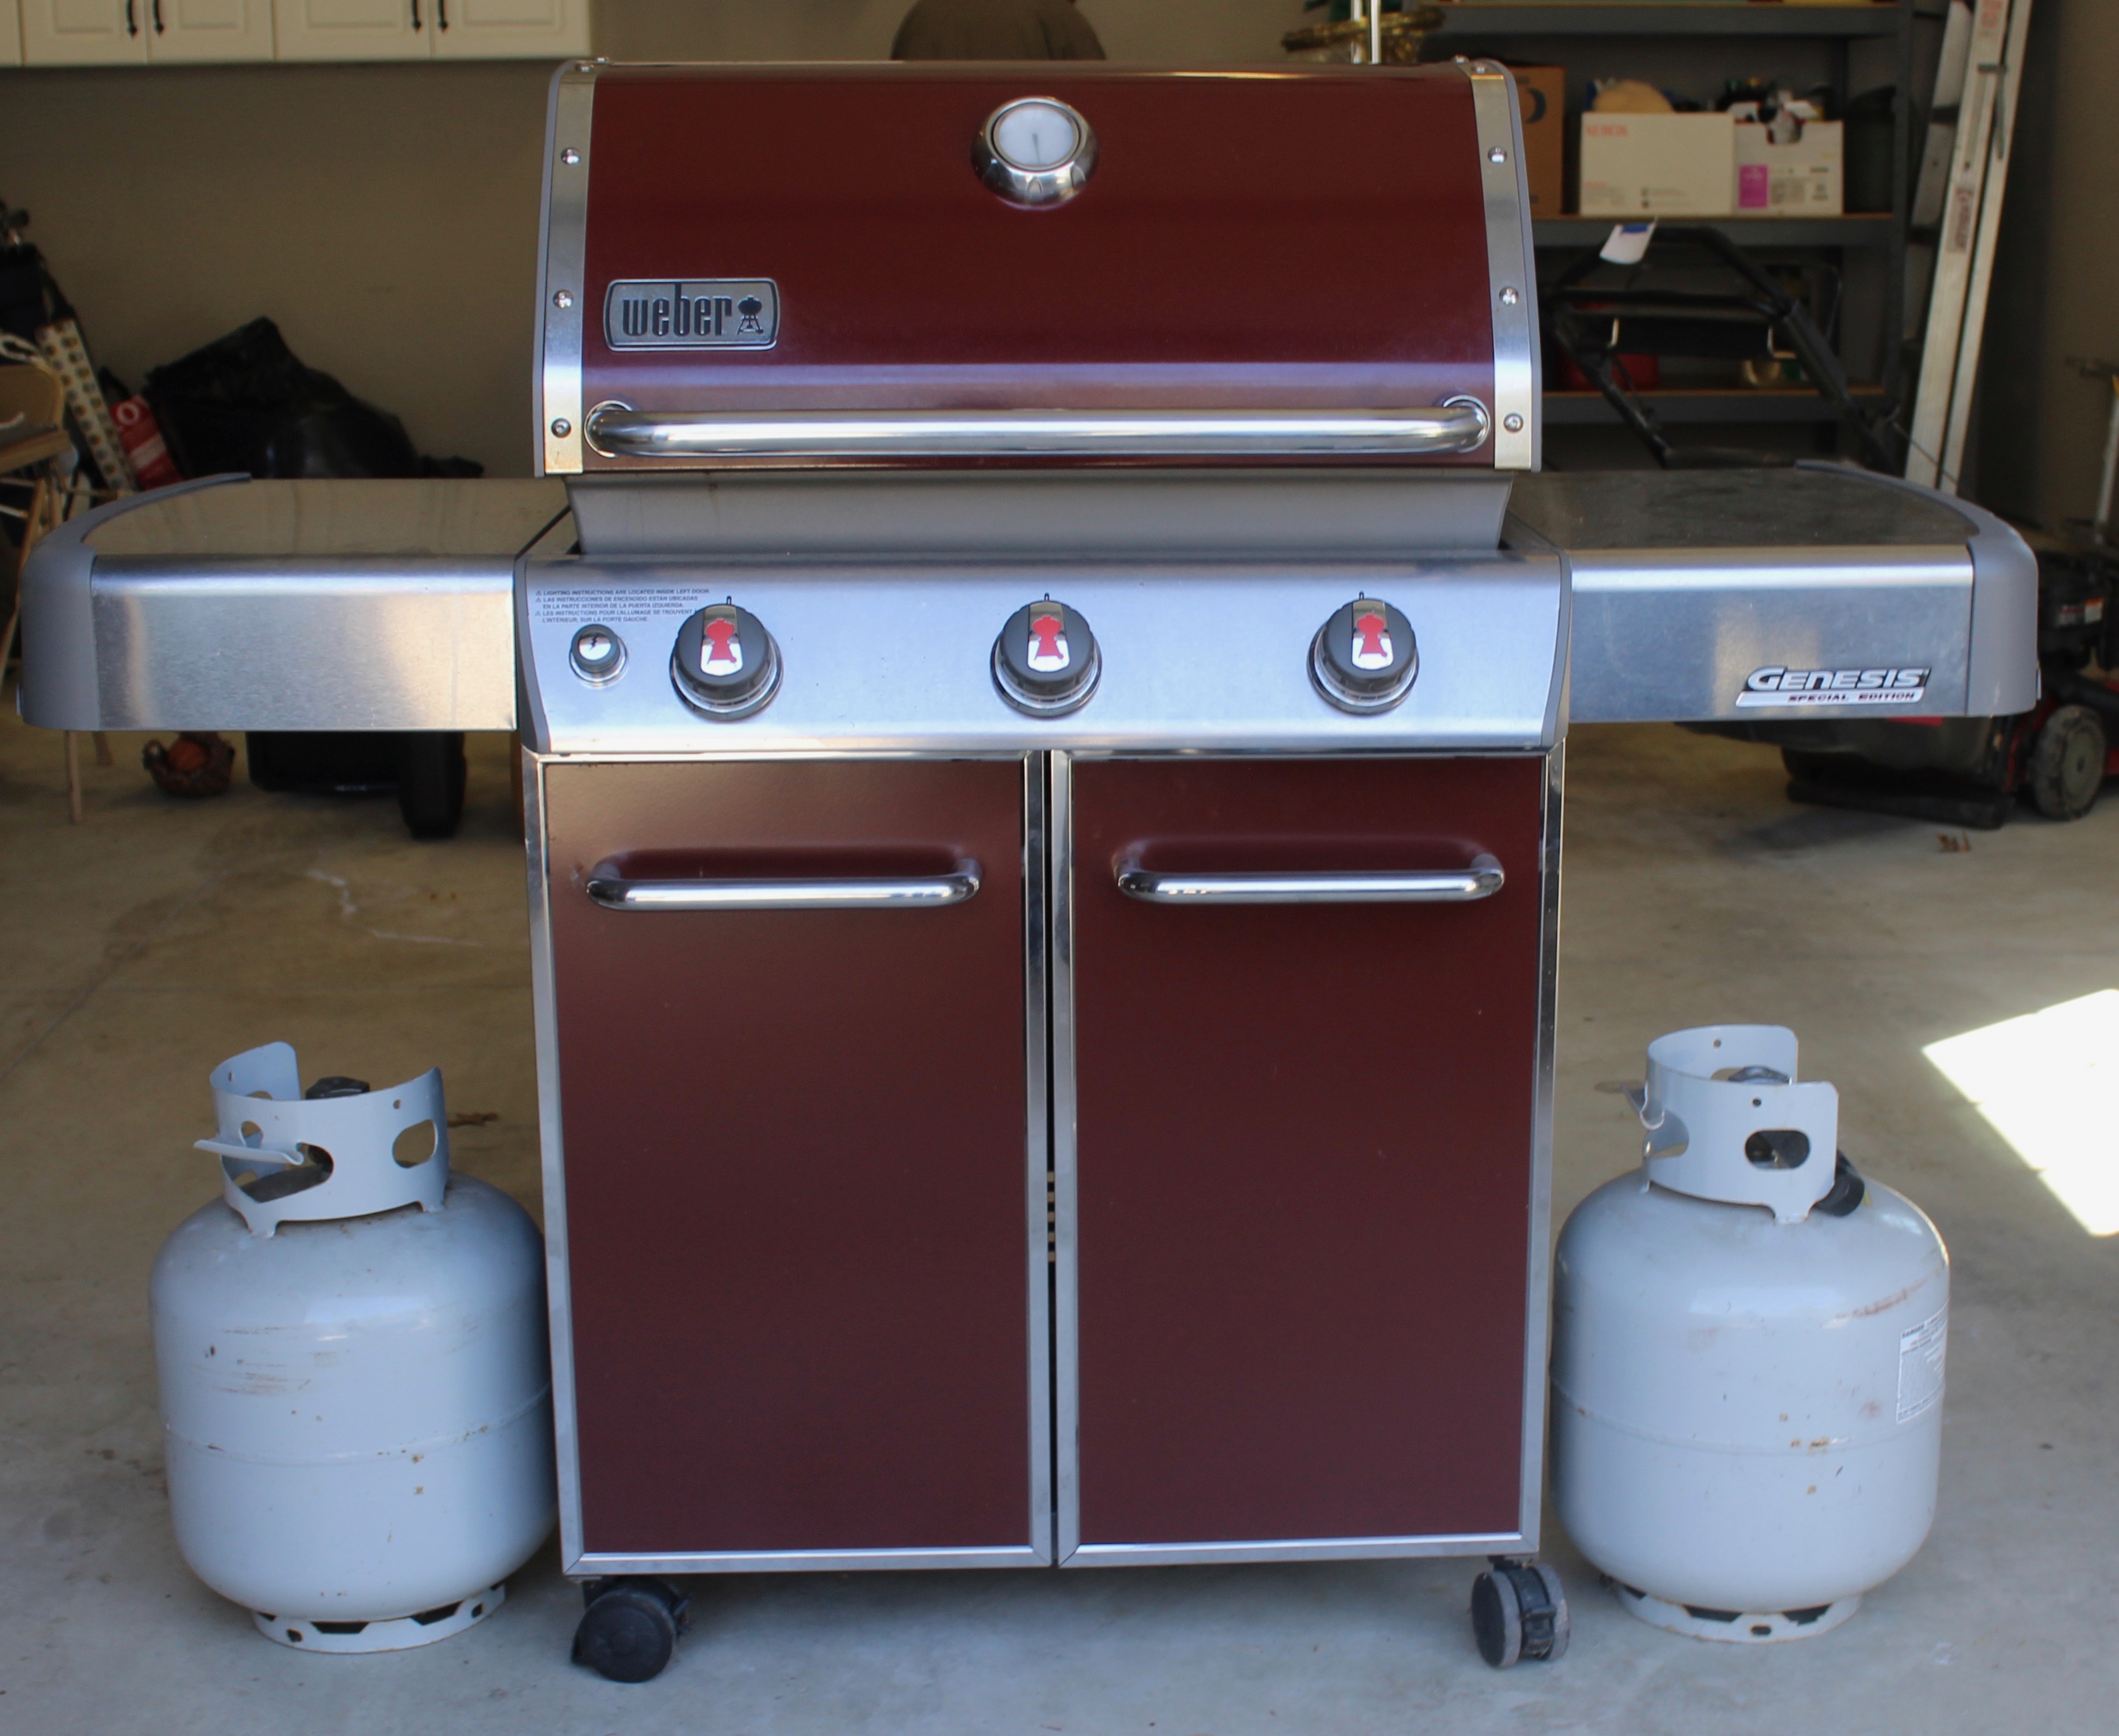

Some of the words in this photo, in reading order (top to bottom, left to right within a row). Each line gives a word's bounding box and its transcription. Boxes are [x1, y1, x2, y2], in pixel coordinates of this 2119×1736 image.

[622, 283, 732, 337] weber
[1788, 693, 1849, 704] SPECIAL
[1858, 692, 1915, 702] EDITION
